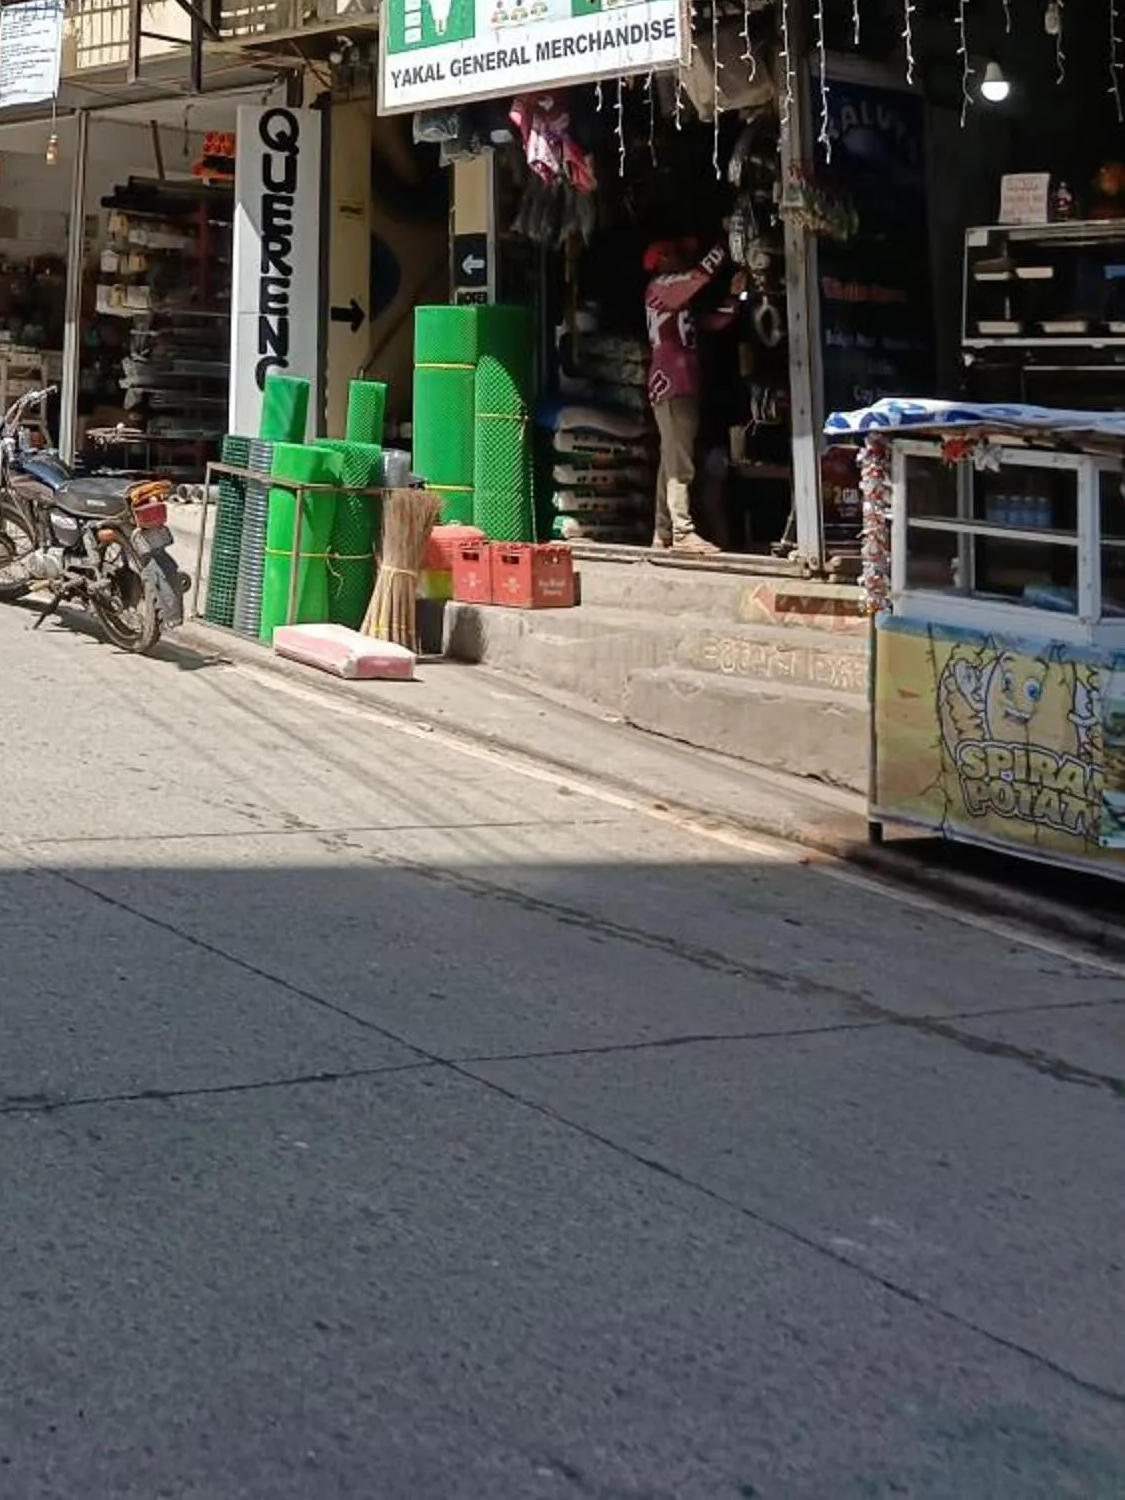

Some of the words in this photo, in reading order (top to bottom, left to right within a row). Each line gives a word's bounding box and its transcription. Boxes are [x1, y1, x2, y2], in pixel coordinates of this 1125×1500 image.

[391, 62, 445, 88] YAKAL
[450, 46, 530, 78] GENERAL
[536, 17, 676, 62] MERCHANDISE
